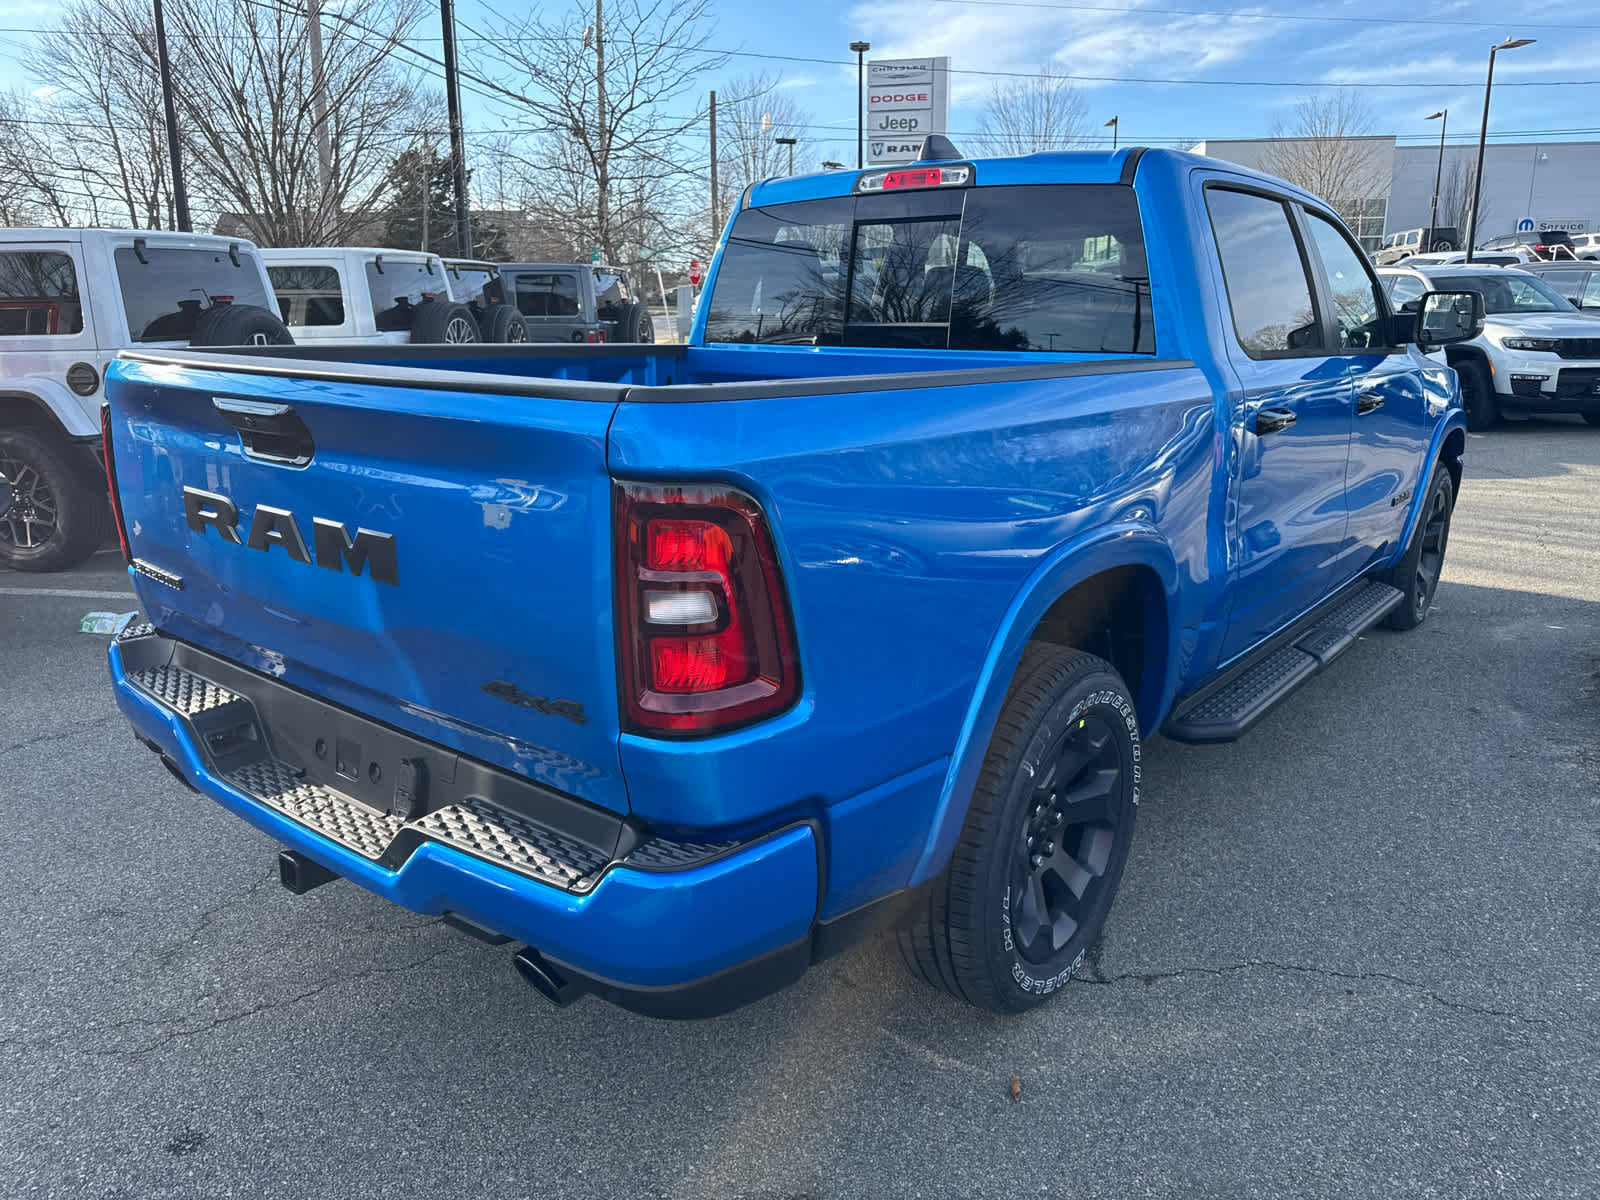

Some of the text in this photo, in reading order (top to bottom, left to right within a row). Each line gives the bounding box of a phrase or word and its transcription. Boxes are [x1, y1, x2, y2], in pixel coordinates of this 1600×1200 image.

[870, 93, 928, 104] DODGE
[879, 115, 918, 132] Jeep
[1540, 222, 1584, 231] Service
[183, 486, 400, 586] RAM
[1012, 948, 1085, 995] DUELER
